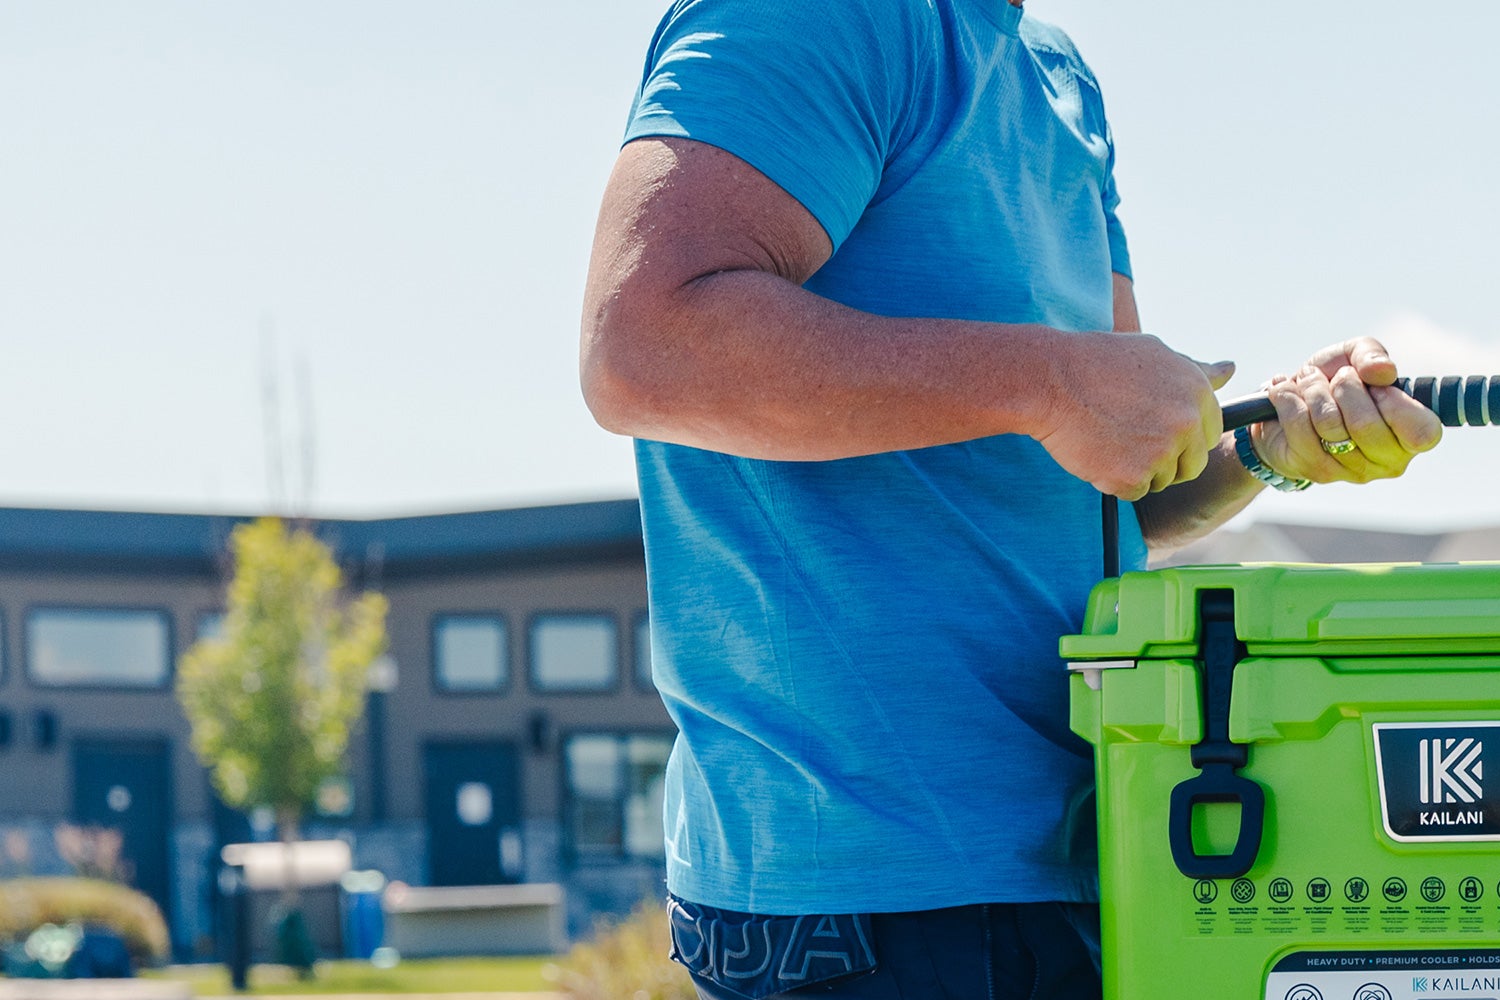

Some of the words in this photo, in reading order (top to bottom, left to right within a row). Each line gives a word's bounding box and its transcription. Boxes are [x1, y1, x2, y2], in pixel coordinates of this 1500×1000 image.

[1420, 811, 1483, 825] KAILANI
[1307, 958, 1338, 966] HEAVY
[1341, 958, 1366, 966] DUTY
[1376, 957, 1419, 965] PREMIUM
[1421, 956, 1460, 964] COOLER
[1469, 955, 1500, 964] HOLDS
[1432, 976, 1500, 991] KAILANI
